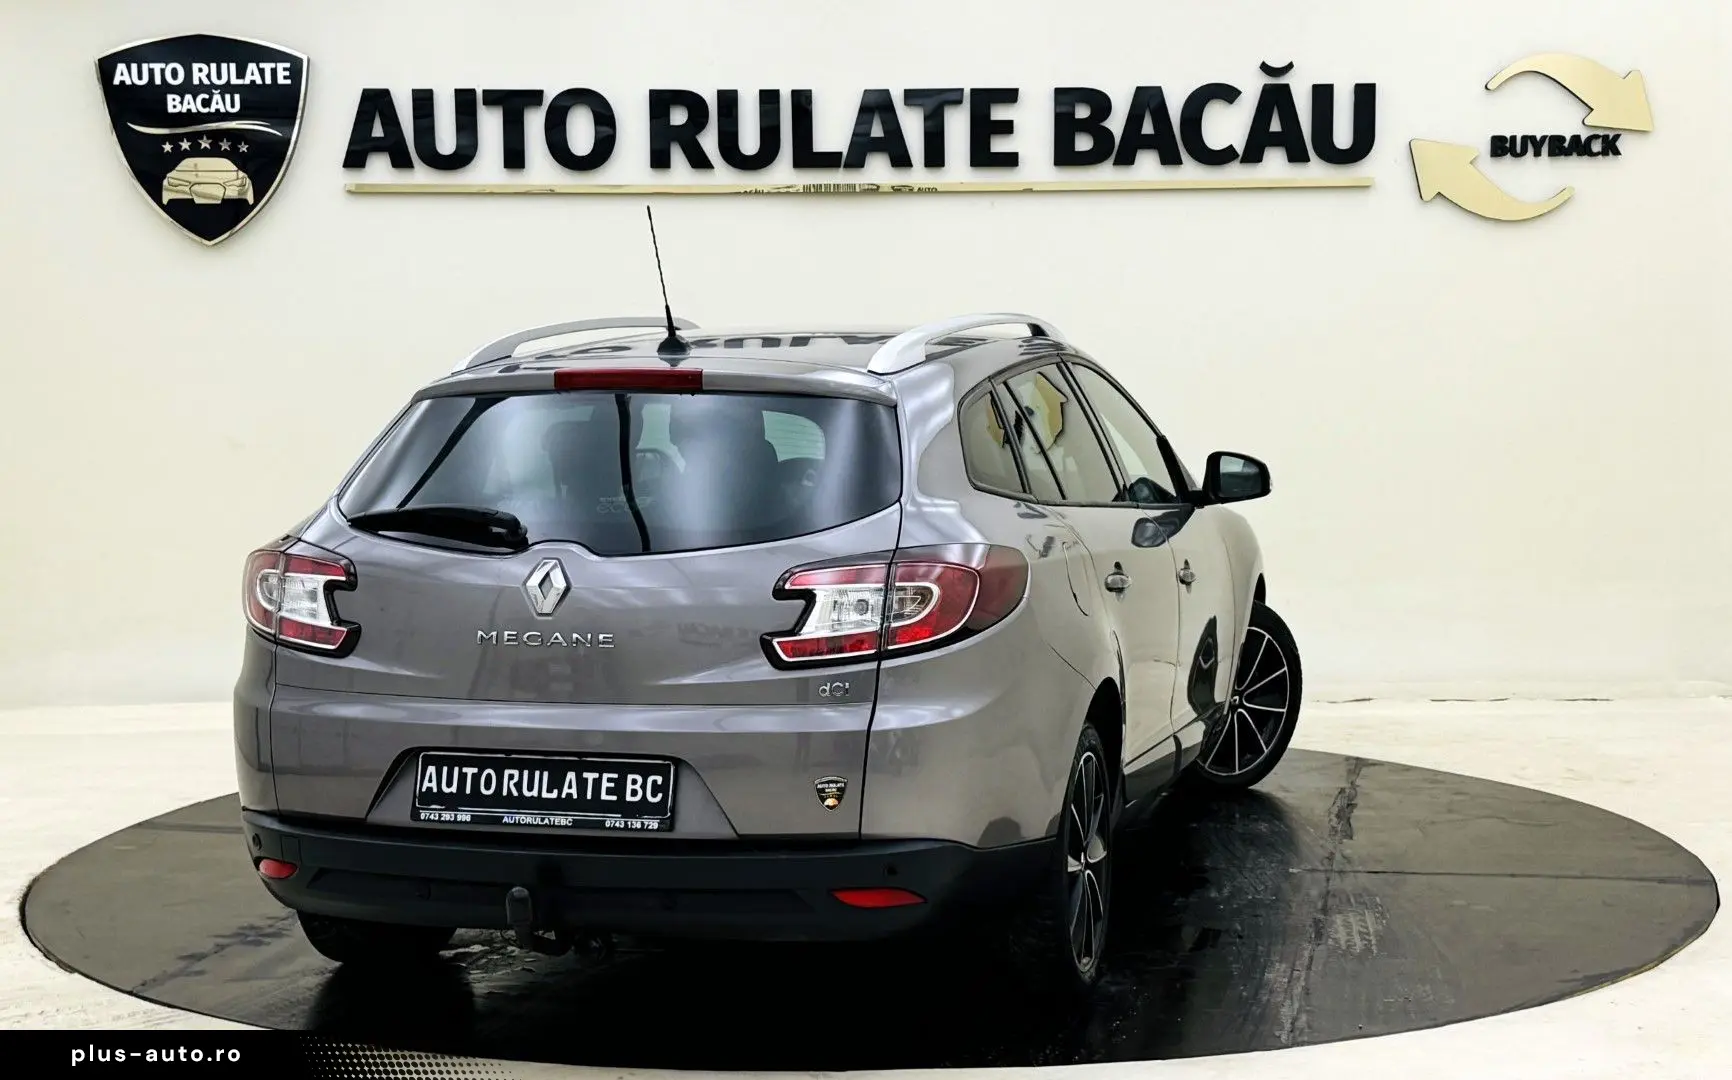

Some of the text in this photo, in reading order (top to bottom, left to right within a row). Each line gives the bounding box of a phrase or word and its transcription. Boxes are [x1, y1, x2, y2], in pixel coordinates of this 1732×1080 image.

[113, 62, 292, 86] AUTO RULATE
[166, 89, 241, 114] BACĂU
[342, 60, 1377, 171] AUTO RULATE BACĂU
[1490, 133, 1622, 158] BUYBACK
[476, 630, 615, 648] MEGANE
[421, 765, 663, 803] AUTO RULATE BC
[420, 812, 439, 821] 0743
[440, 813, 455, 822] 293
[502, 815, 574, 826] AUTORULATEBC
[605, 819, 659, 830] 0743 136 729
